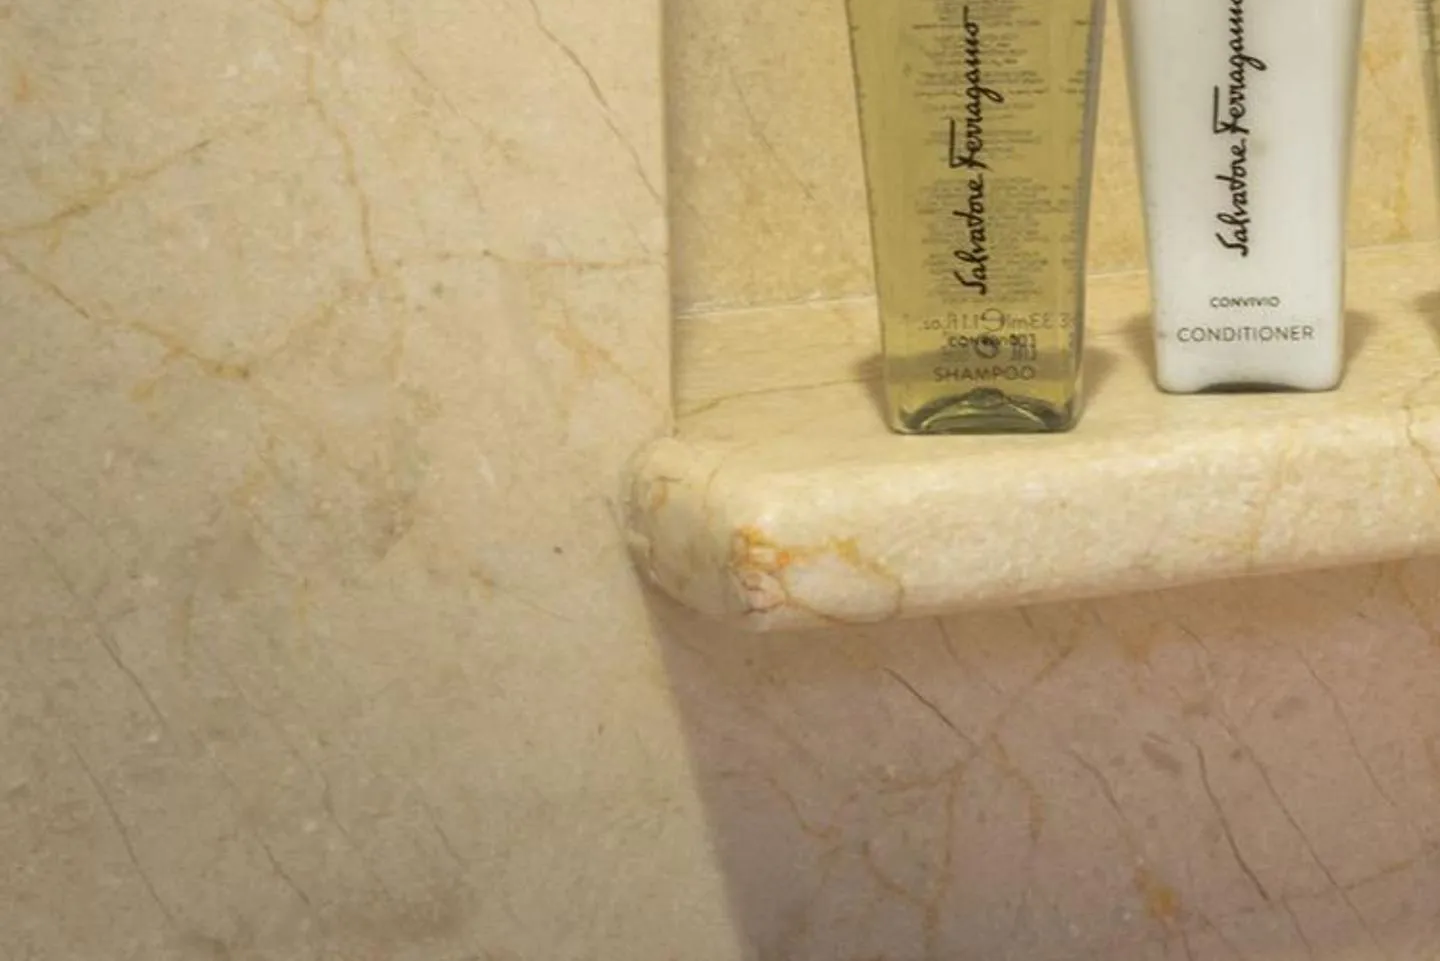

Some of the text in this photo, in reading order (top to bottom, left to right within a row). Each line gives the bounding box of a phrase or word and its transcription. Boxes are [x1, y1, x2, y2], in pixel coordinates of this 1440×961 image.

[949, 5, 1004, 296] Salvatore Ferragamo
[1214, 138, 1251, 258] Salvatore
[1209, 295, 1281, 309] CONVIVIO
[1176, 324, 1315, 343] CONDITIONER
[932, 364, 1036, 382] SHAMPOO
